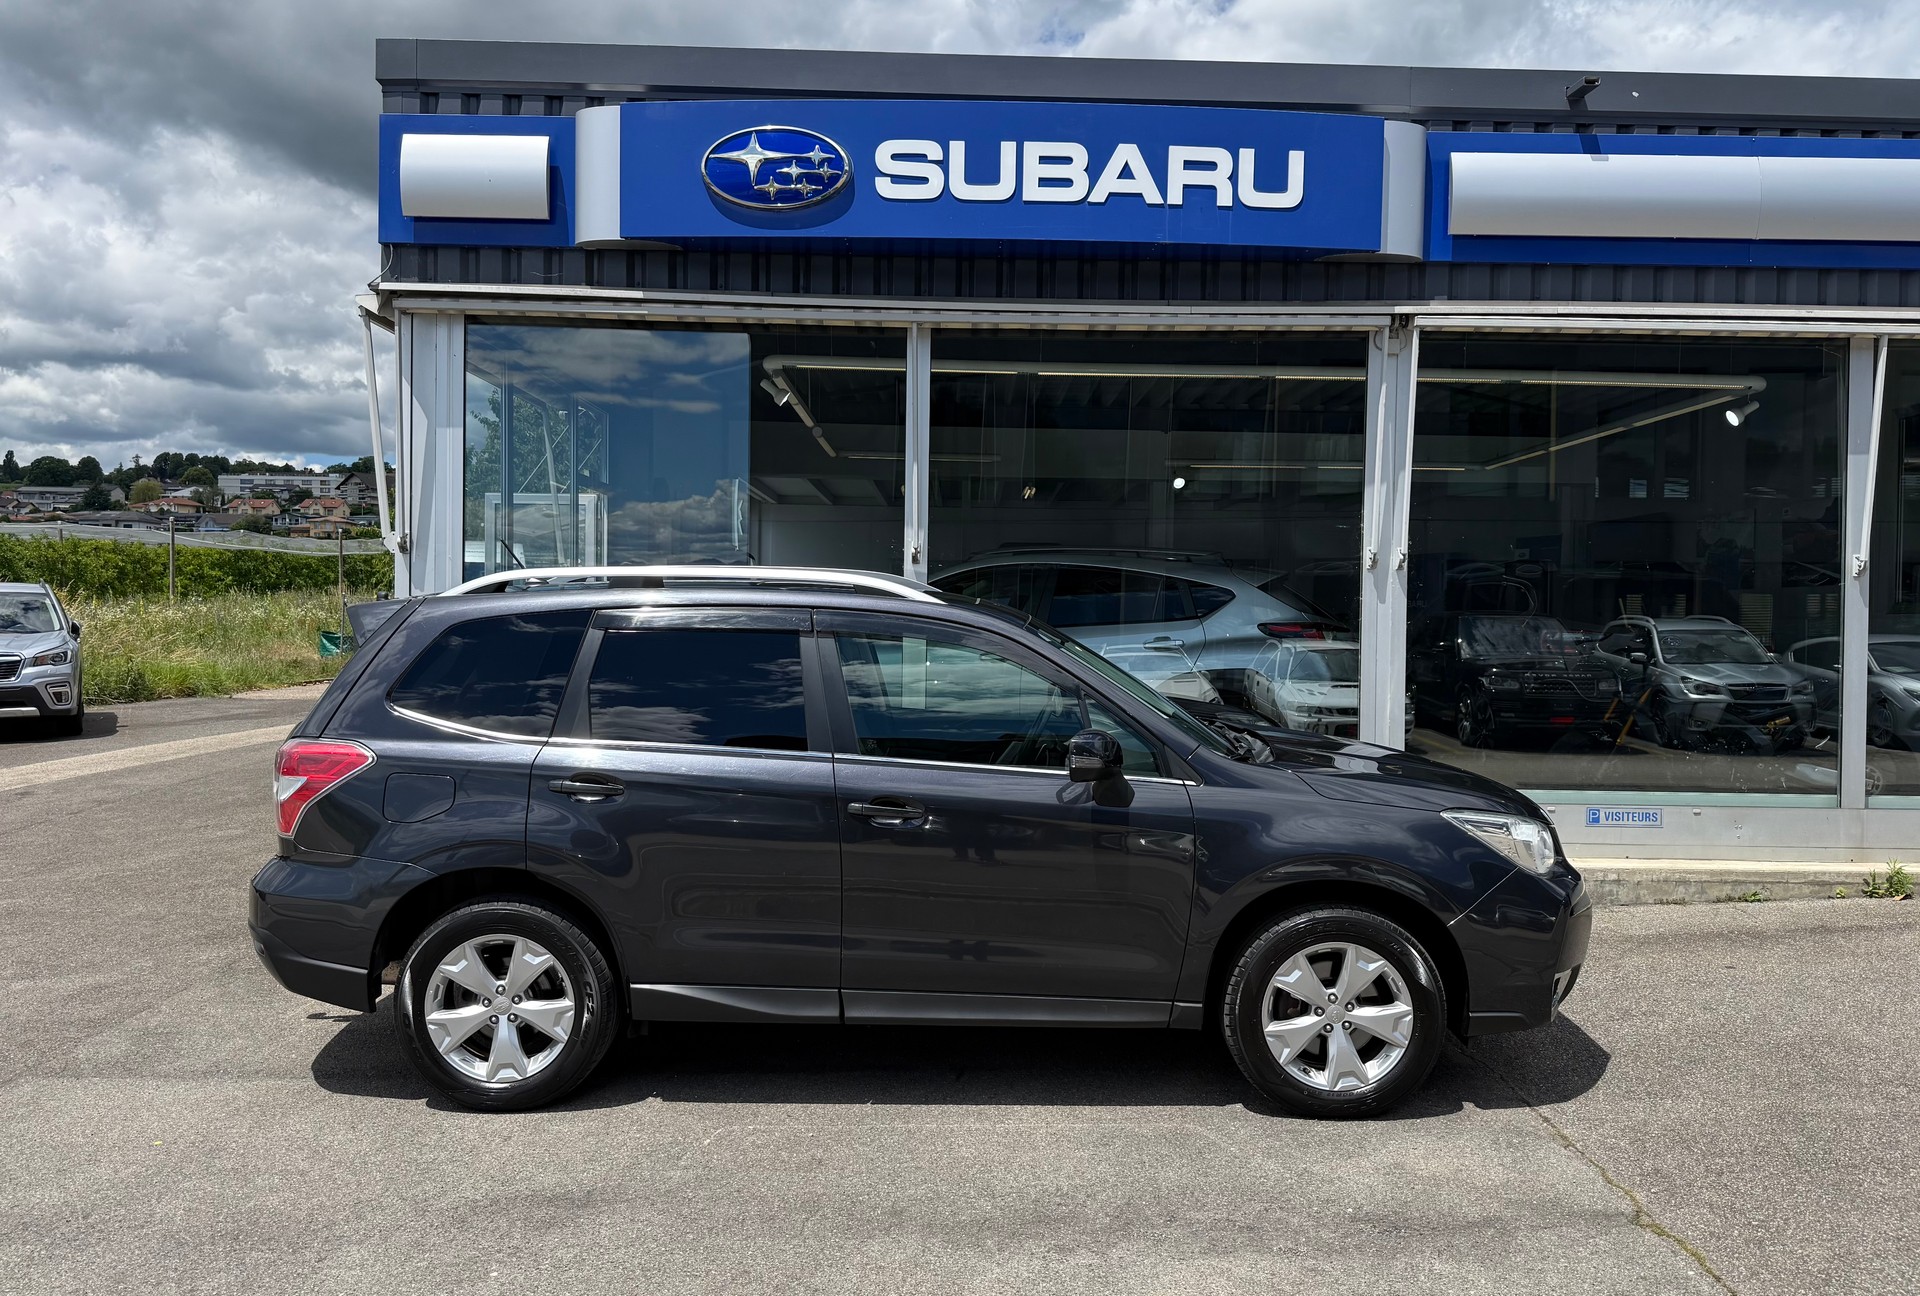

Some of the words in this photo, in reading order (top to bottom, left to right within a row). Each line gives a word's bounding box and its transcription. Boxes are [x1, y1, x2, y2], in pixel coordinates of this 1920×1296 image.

[875, 139, 1305, 209] SUBARU
[1589, 810, 1600, 822] P
[1604, 811, 1658, 823] VISITEURS
